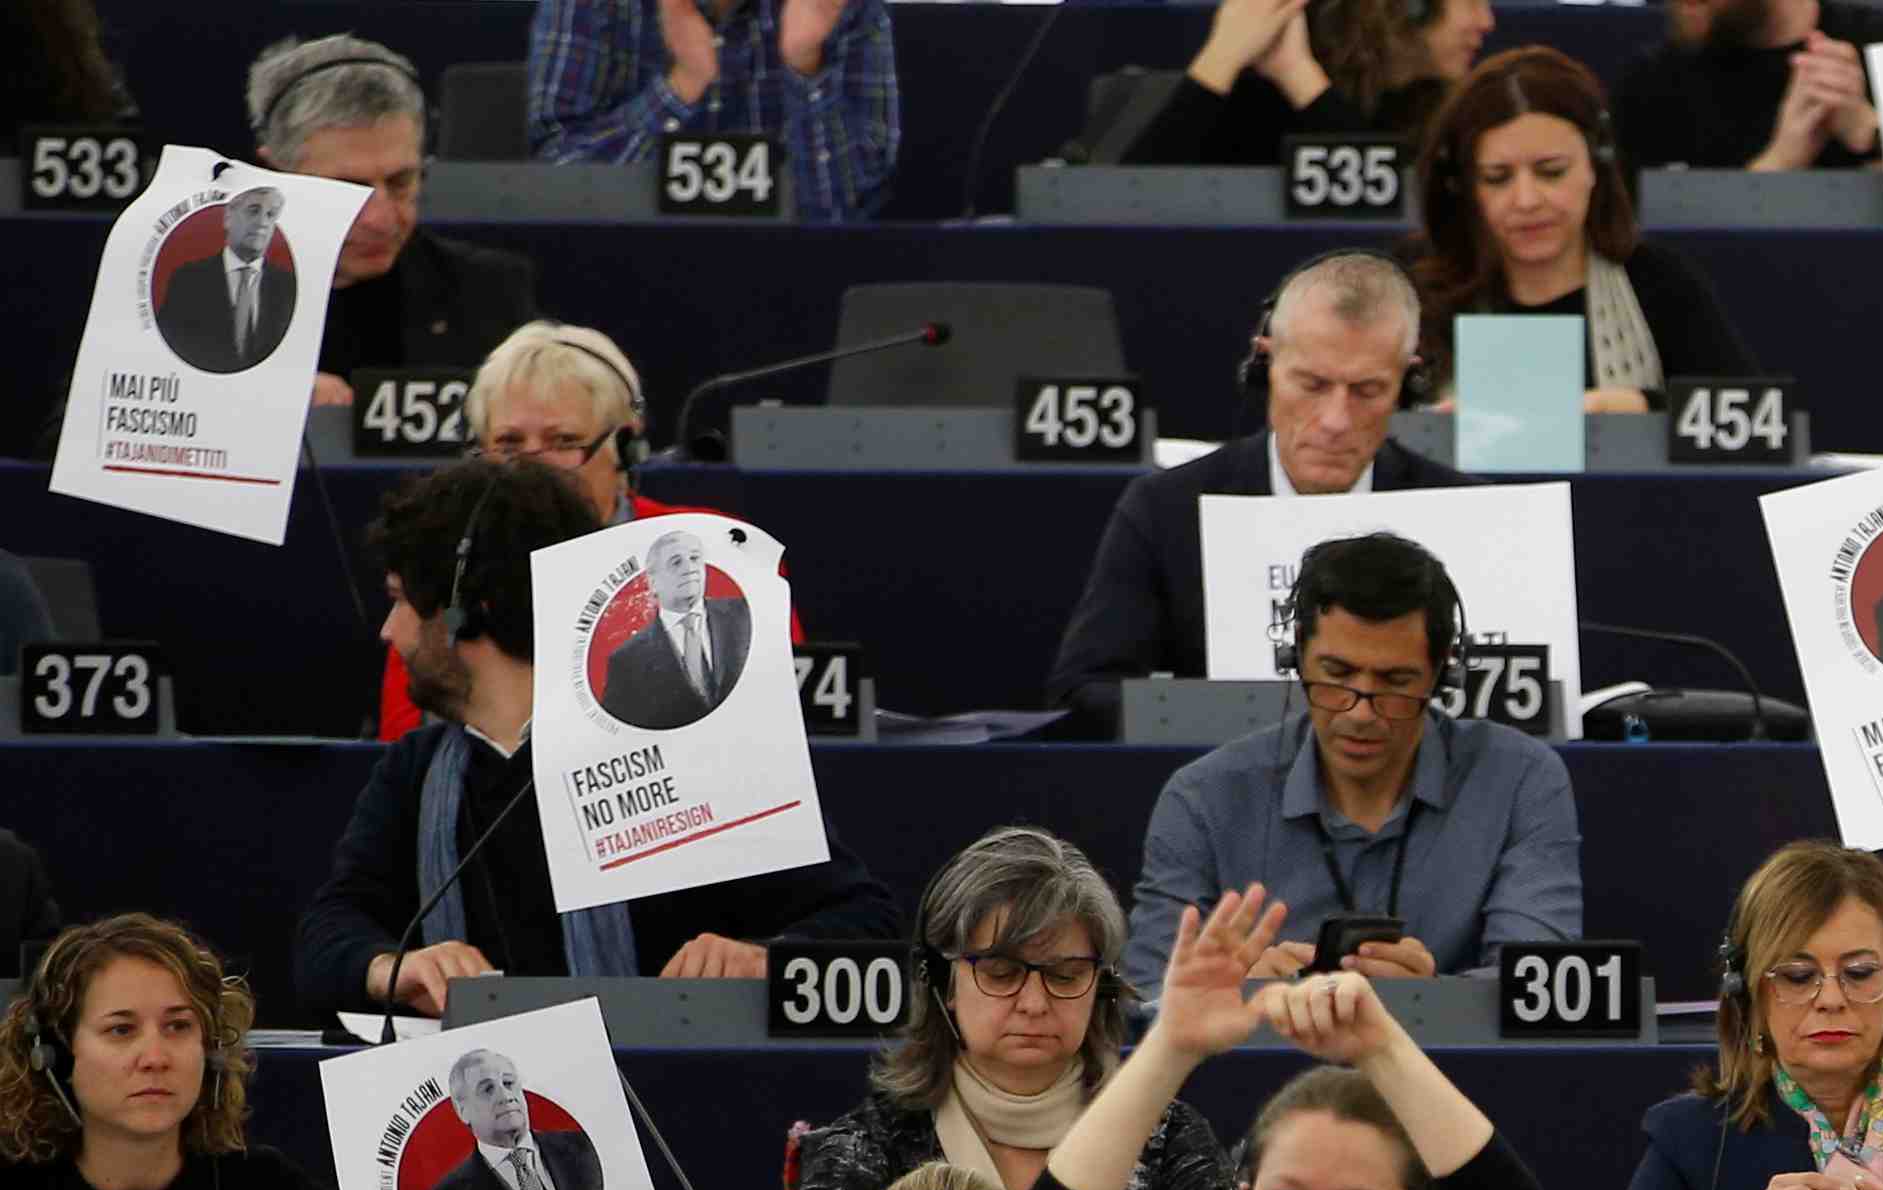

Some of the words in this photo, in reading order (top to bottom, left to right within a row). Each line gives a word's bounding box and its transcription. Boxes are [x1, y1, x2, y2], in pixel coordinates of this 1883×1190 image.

[33, 139, 139, 198] 533
[667, 143, 772, 203] 534
[1294, 147, 1397, 205] 535
[108, 372, 145, 401] MAI
[363, 380, 467, 442] 452
[1026, 386, 1134, 447] 453
[106, 405, 198, 438] FASCISMO
[1677, 388, 1788, 450] 454
[104, 440, 228, 470] #TAJANIDIMETTITI
[35, 655, 149, 719] 373
[795, 656, 852, 719] 74
[572, 743, 665, 797] FASCISM
[581, 800, 613, 831] NO
[615, 776, 681, 822] MORE
[595, 802, 713, 858] #TAJANIRESIGN
[783, 957, 902, 1024] 300
[1513, 955, 1622, 1022] 301
[376, 1112, 411, 1168] ANTONIO
[400, 1077, 444, 1120] TAJANI
